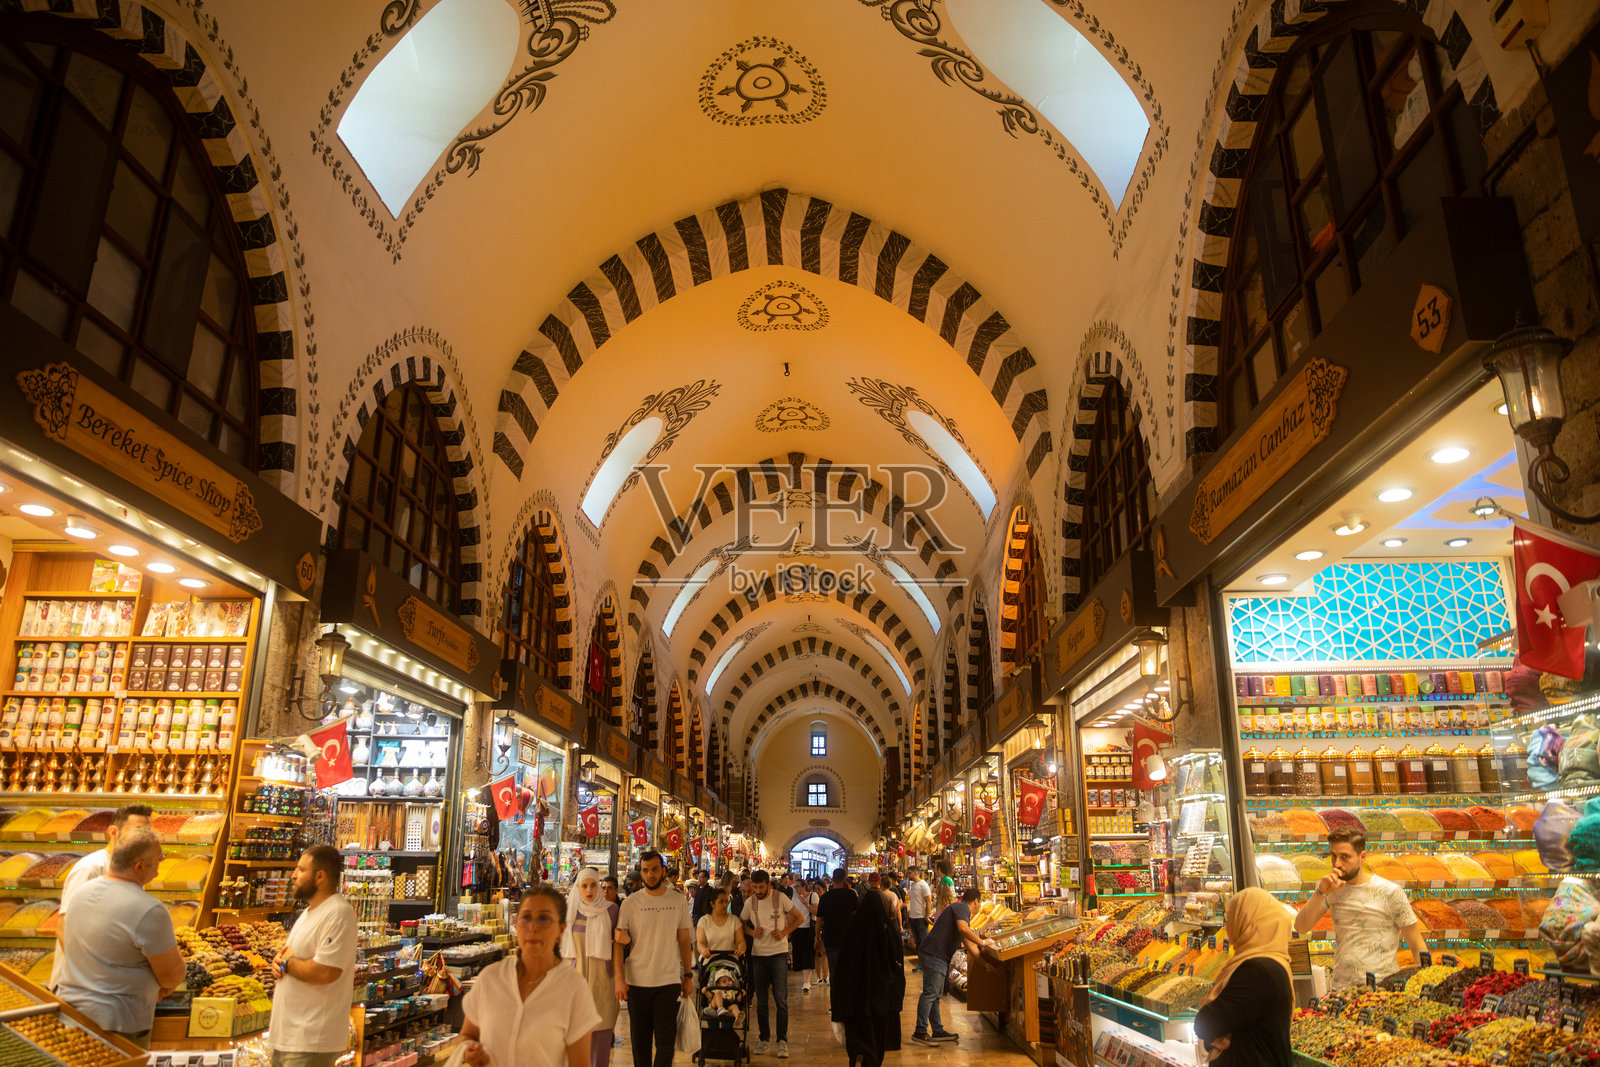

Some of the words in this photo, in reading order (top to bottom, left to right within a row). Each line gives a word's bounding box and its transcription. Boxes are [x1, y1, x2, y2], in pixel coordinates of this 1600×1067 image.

[1416, 295, 1441, 339] 53
[76, 403, 150, 464] Bereket
[151, 448, 193, 491] Spice
[195, 478, 231, 517] Shop
[1208, 452, 1258, 514] Ramazan
[1260, 401, 1306, 462] Canbaz
[301, 560, 313, 581] 60
